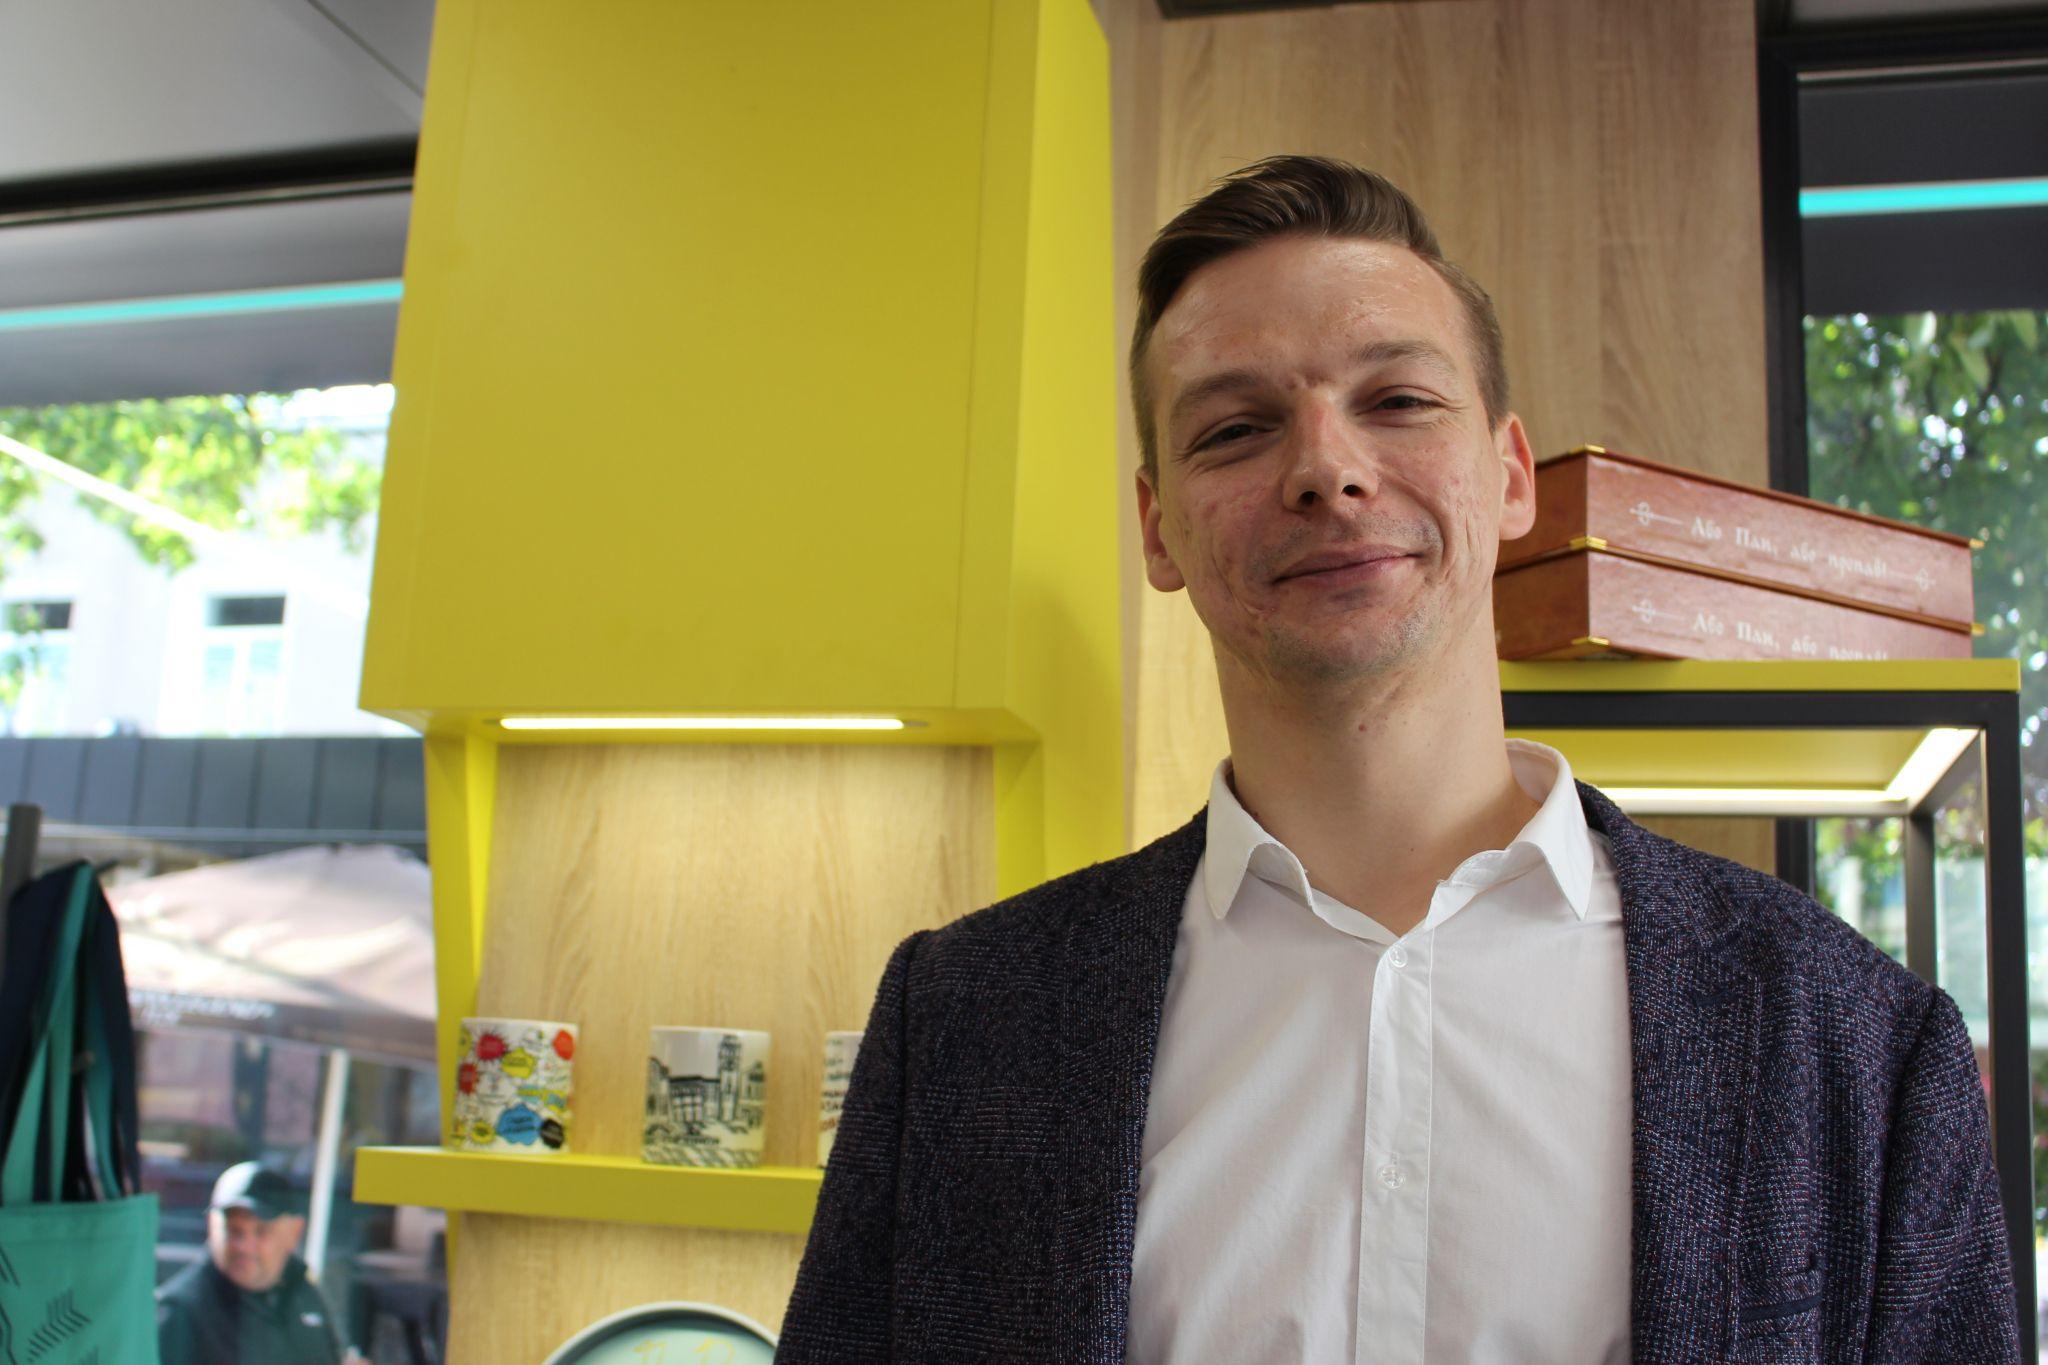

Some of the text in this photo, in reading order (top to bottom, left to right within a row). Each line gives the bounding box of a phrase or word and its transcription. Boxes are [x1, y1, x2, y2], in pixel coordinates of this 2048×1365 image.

[1691, 516, 1722, 540] Або
[1735, 527, 1778, 556] Пан,
[1790, 542, 1816, 562] або
[1692, 613, 1725, 636] Або
[1737, 621, 1780, 652] Пан,
[1792, 635, 1817, 655] або
